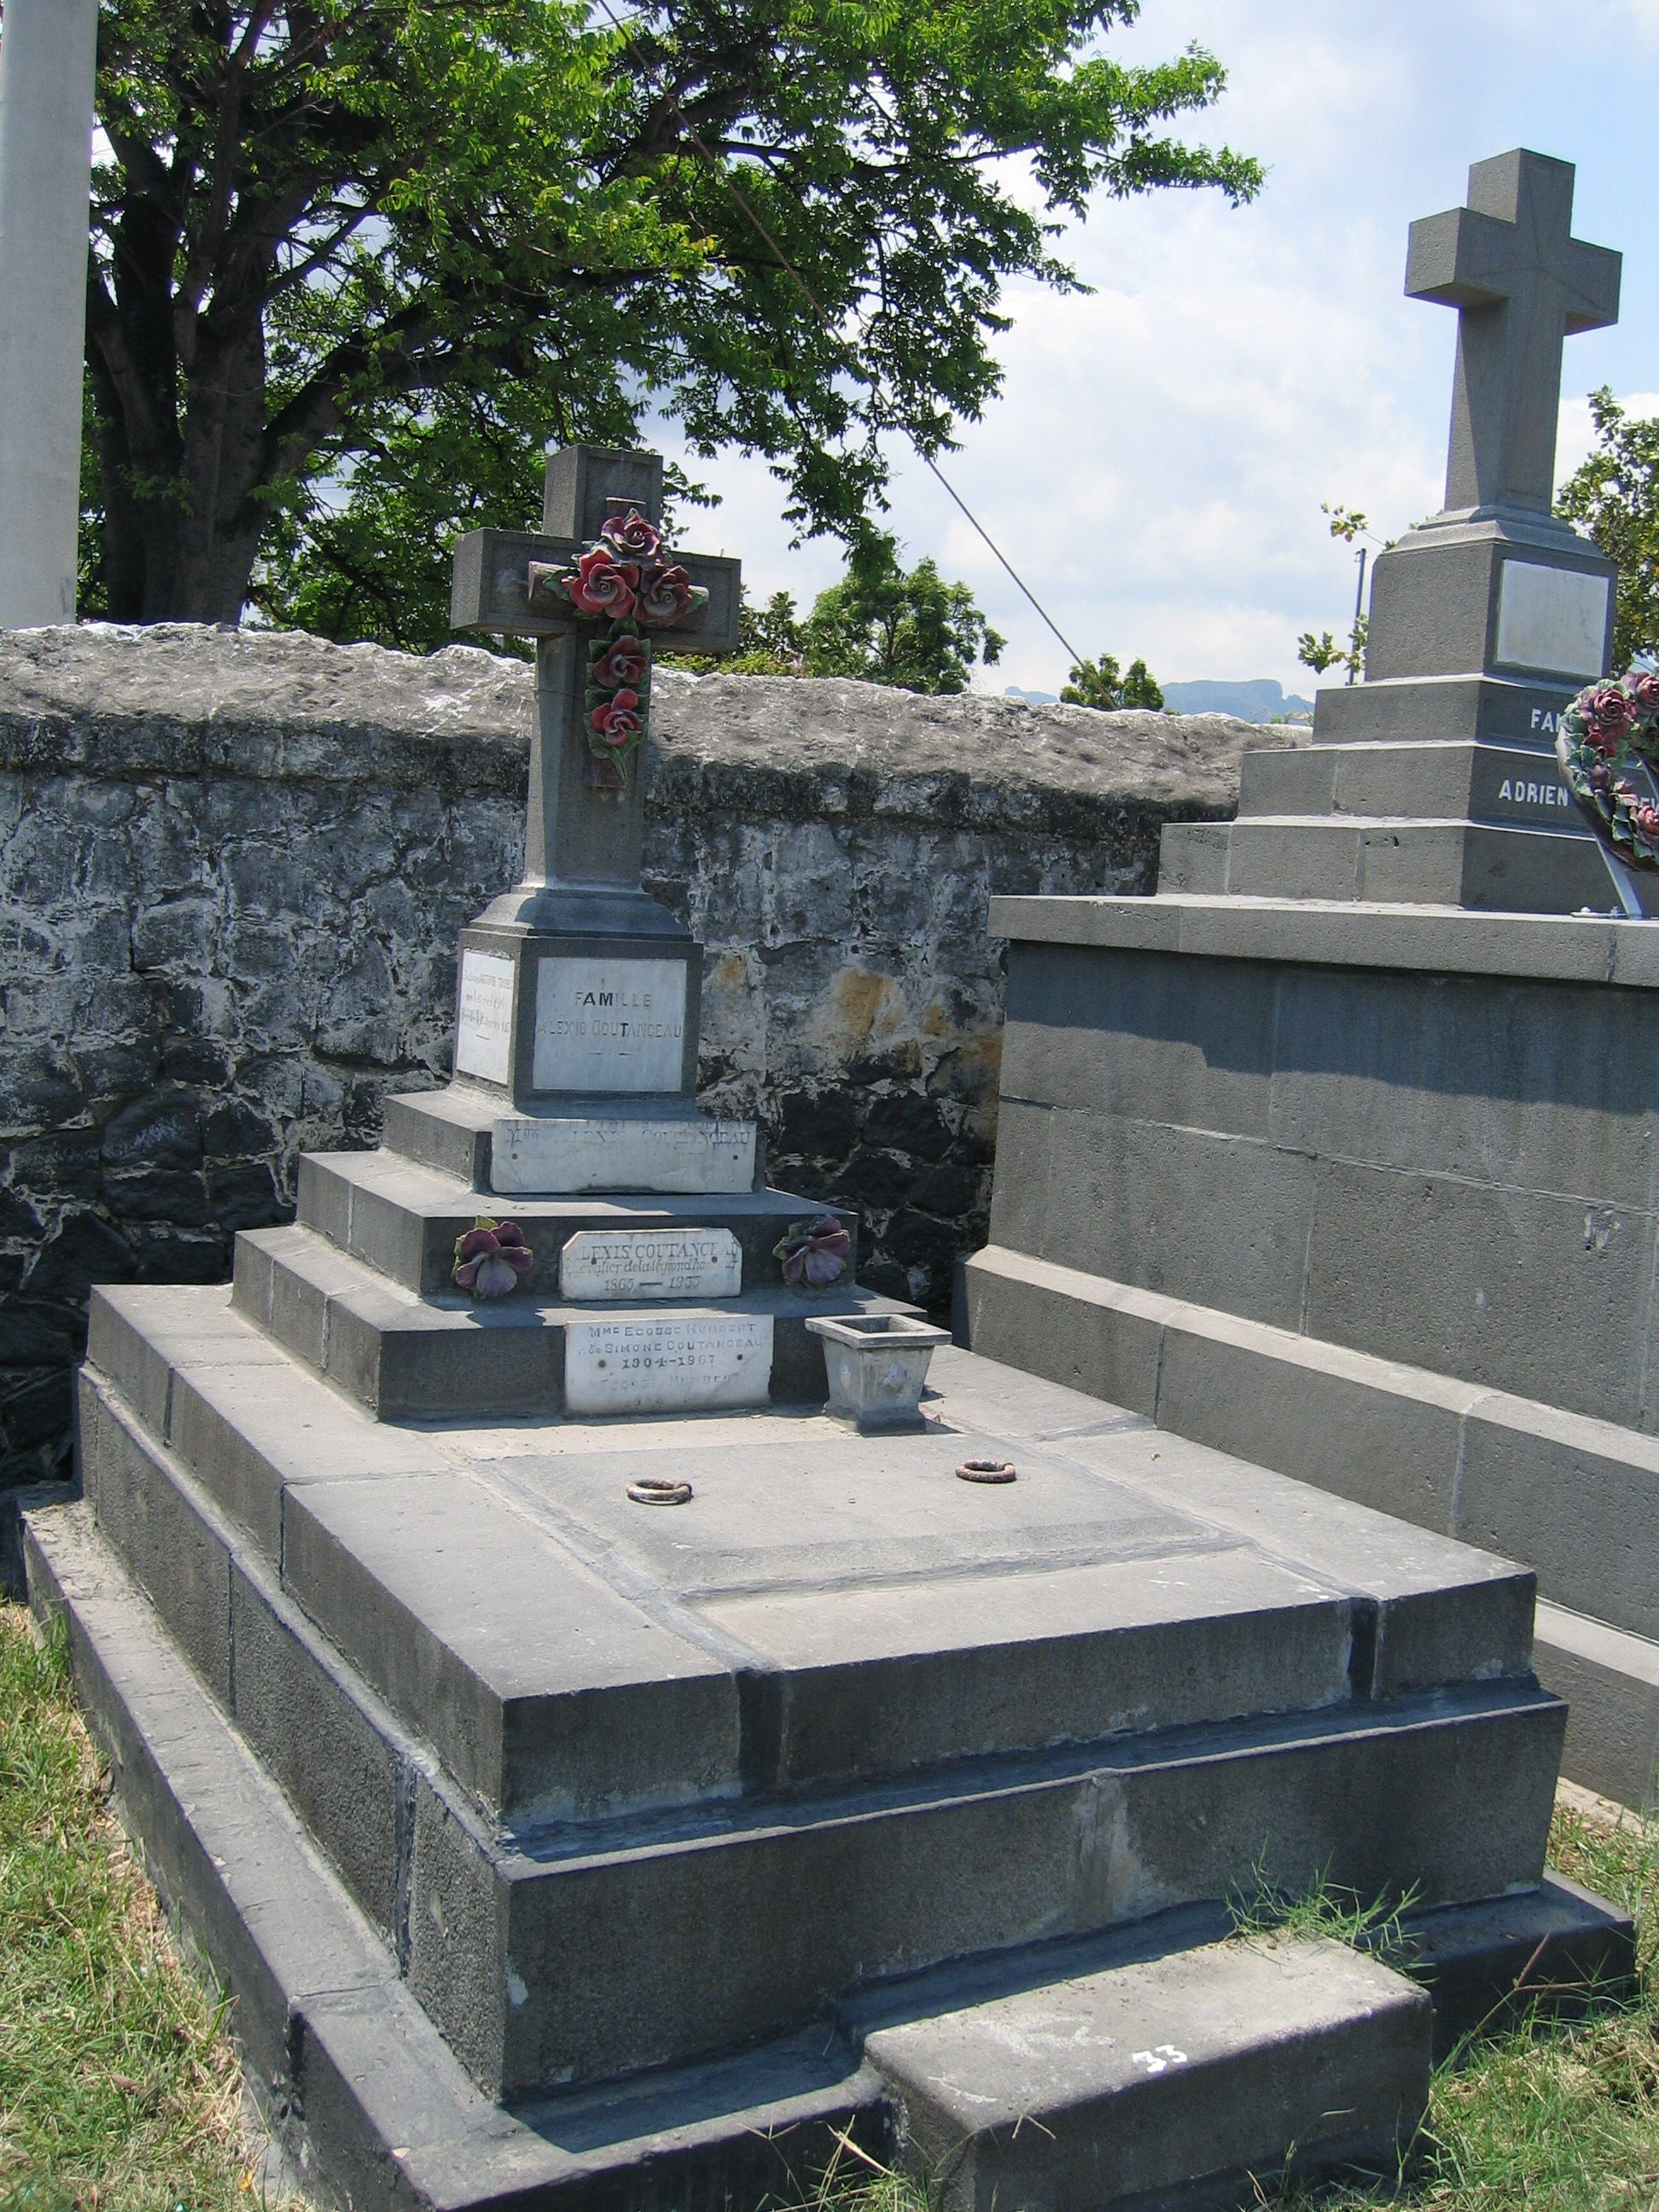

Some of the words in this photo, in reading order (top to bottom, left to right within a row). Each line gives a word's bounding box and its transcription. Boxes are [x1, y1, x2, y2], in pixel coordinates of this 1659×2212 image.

[1498, 778, 1570, 807] ADRIEN
[573, 991, 653, 1008] FAMILLE
[536, 1020, 586, 1036] ALEXIS
[591, 1020, 682, 1039] COUTANCEAU
[566, 1243, 632, 1261] ALEXIS
[634, 1242, 739, 1260] COUTANCEAU
[604, 1278, 635, 1291] 1865
[624, 1326, 681, 1336] ECOSSE
[604, 1342, 662, 1354] SIMONE
[667, 1337, 763, 1352] COUTANCEAU
[1132, 2043, 1189, 2074] 33
